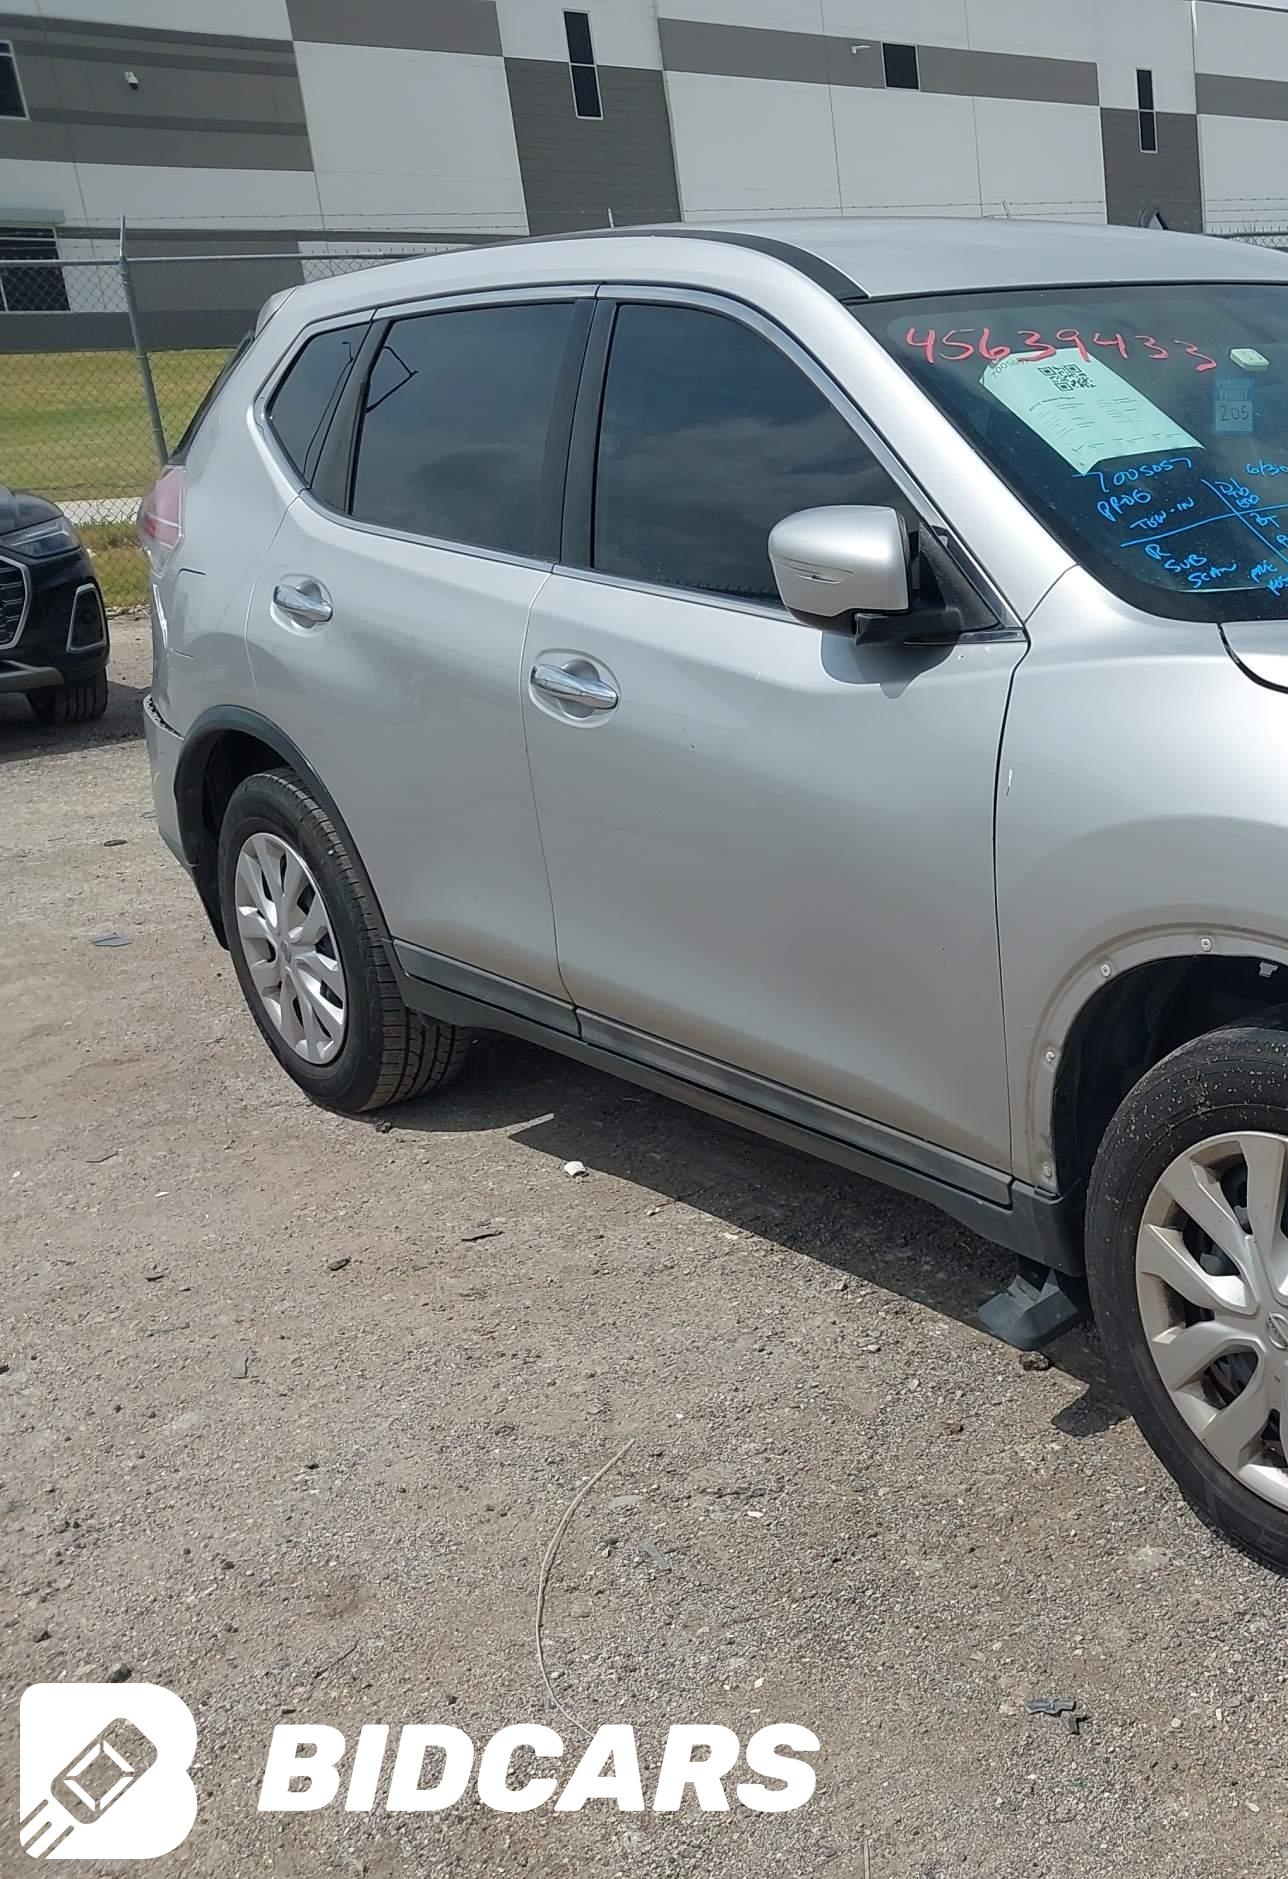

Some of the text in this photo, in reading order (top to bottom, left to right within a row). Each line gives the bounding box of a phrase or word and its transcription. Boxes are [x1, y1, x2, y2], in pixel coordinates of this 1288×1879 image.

[905, 328, 1217, 372] 45639433
[1219, 404, 1249, 422] 205
[1071, 457, 1193, 492] 7005057
[1164, 553, 1208, 573] SUB
